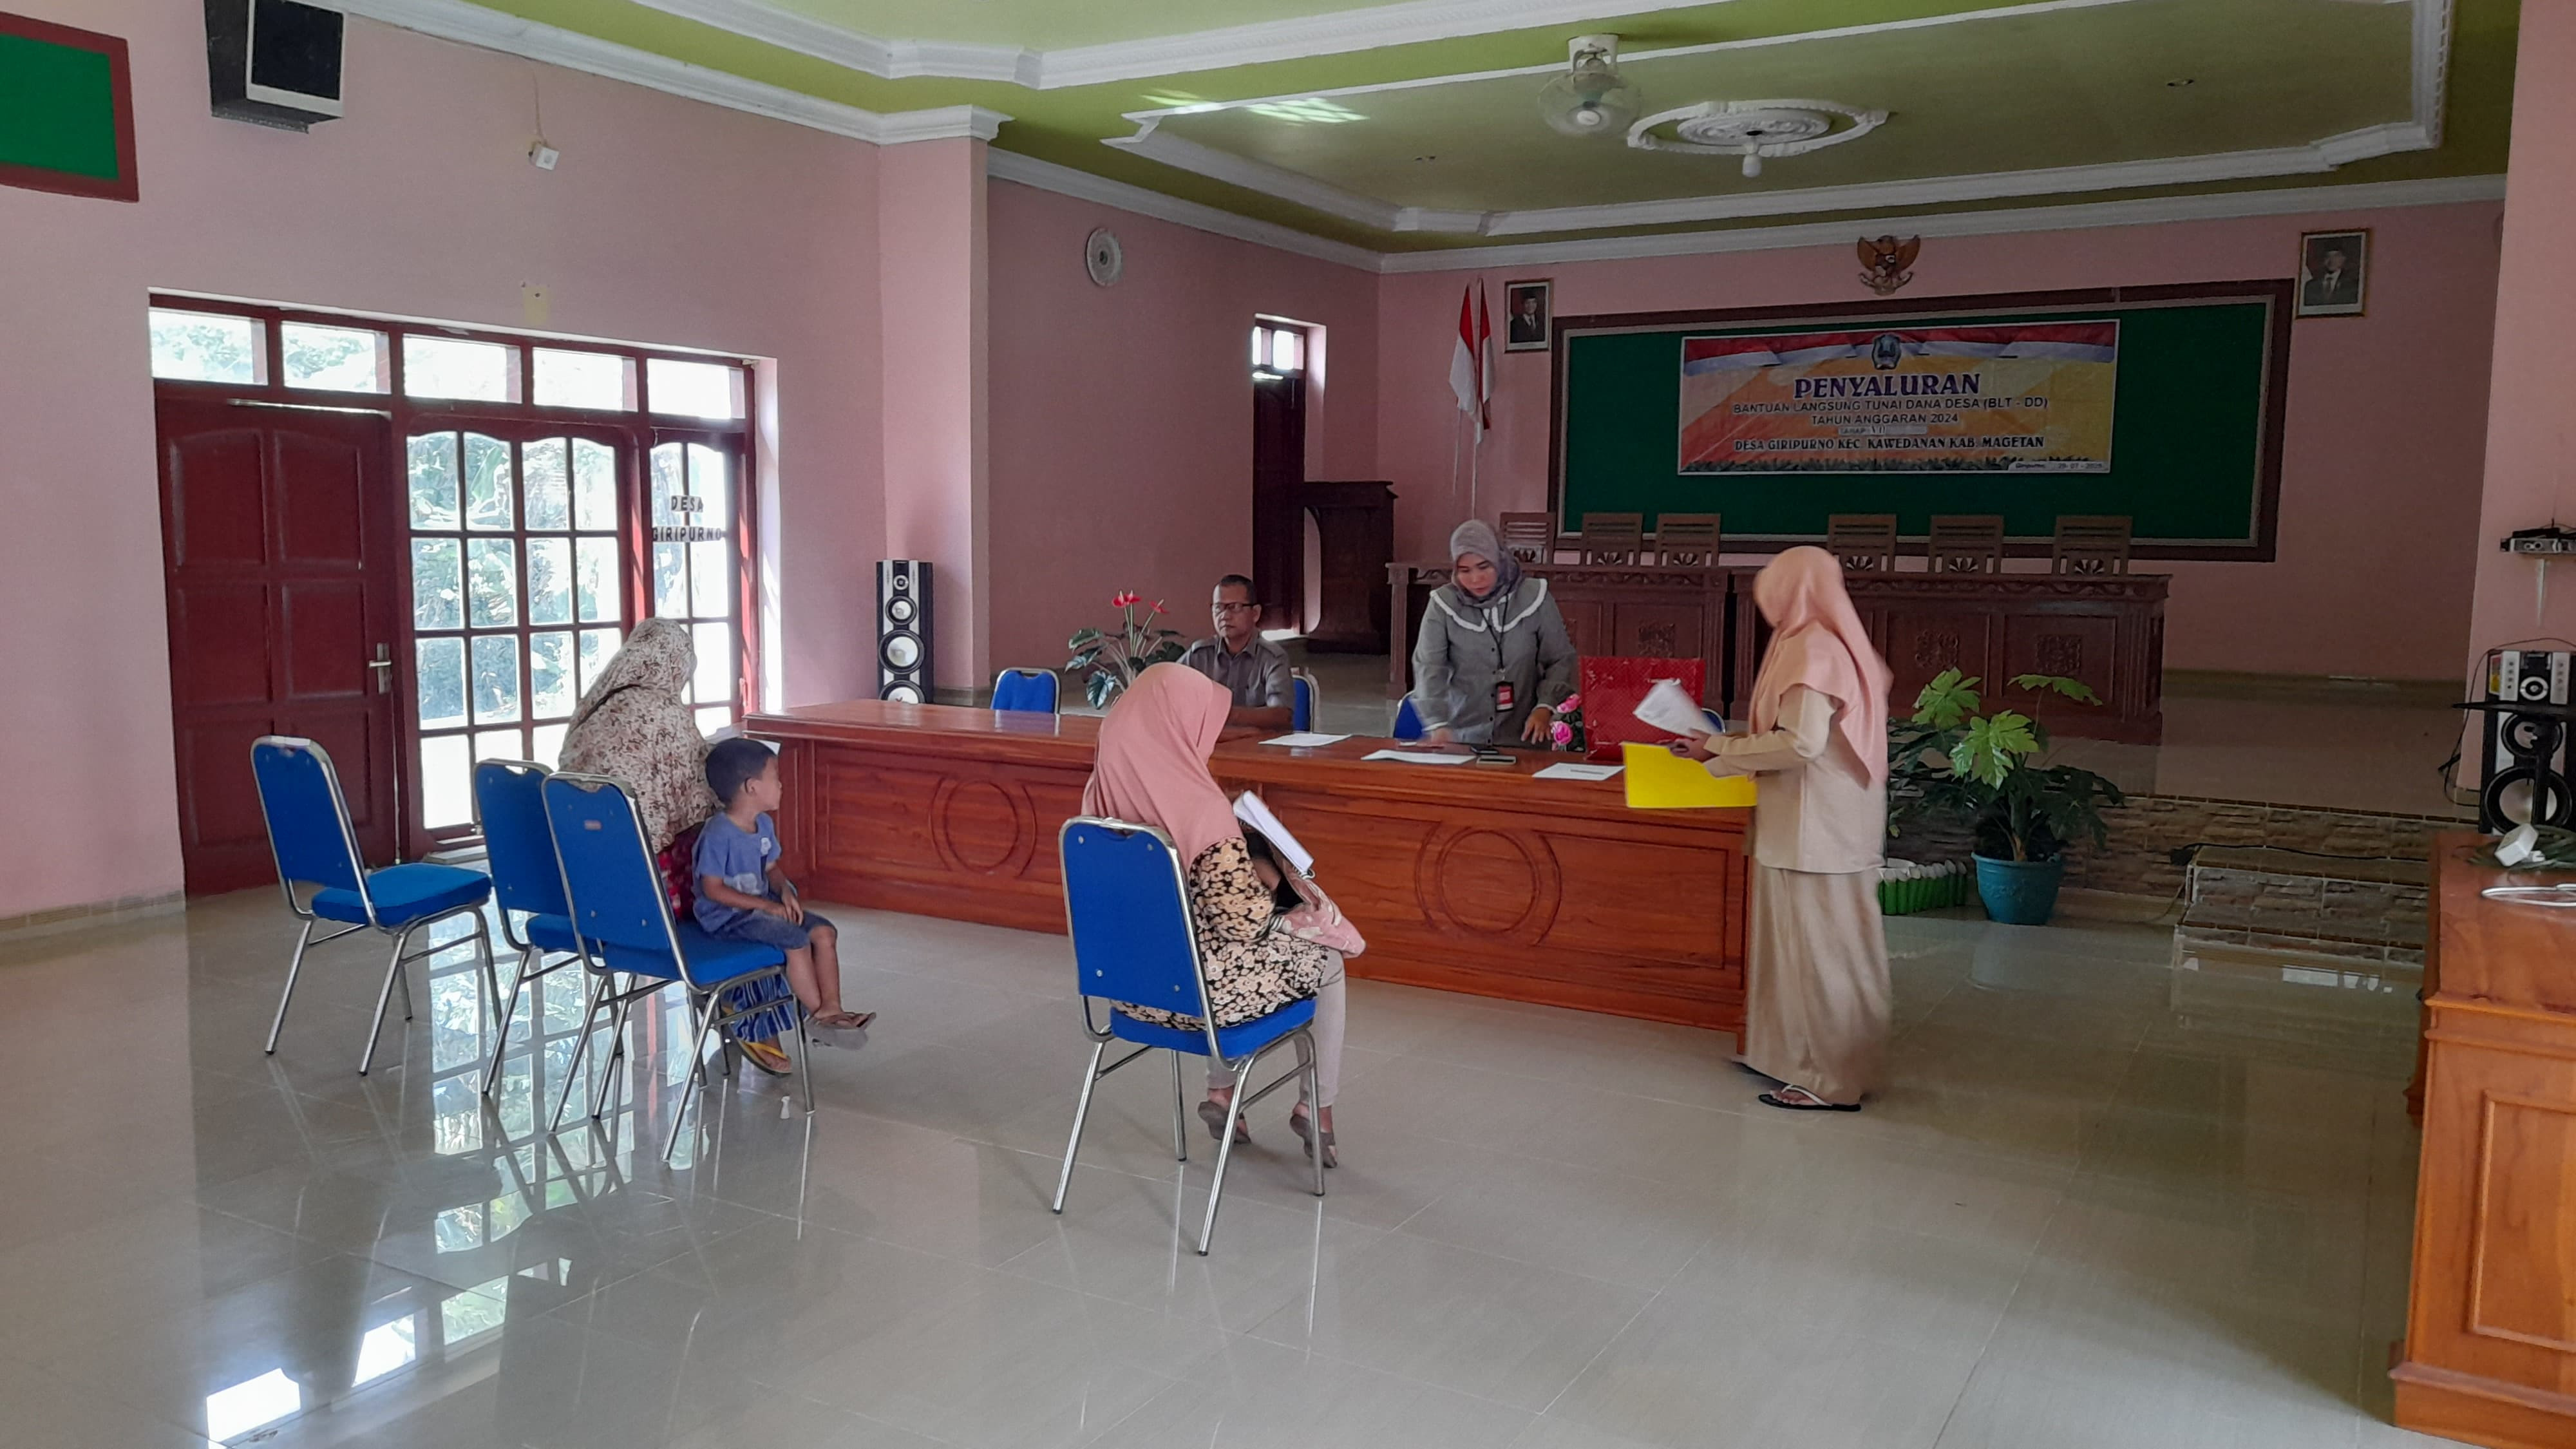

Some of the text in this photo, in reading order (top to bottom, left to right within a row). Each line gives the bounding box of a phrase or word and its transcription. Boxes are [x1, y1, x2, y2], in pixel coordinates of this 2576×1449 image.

[1794, 374, 1980, 399] PENYALURAN
[1734, 403, 1790, 413] BANTUAN
[1794, 401, 1861, 412] LANGSUNG
[1865, 400, 1902, 410] TUNAI
[1906, 399, 1942, 410] DANA
[1945, 398, 1980, 408] DESA
[1984, 397, 2012, 410] (BLT
[2024, 397, 2048, 409] DD)
[1812, 413, 1958, 425] TAHUN ANGGARAN 2024
[1735, 439, 1764, 451] DESA
[1768, 439, 1834, 450] GIRIPURNO
[1868, 437, 1945, 449] KAWEDANAN
[1982, 436, 2045, 448] MAGETAN
[671, 497, 703, 512] DESA
[652, 527, 722, 542] GIRIPURNO
